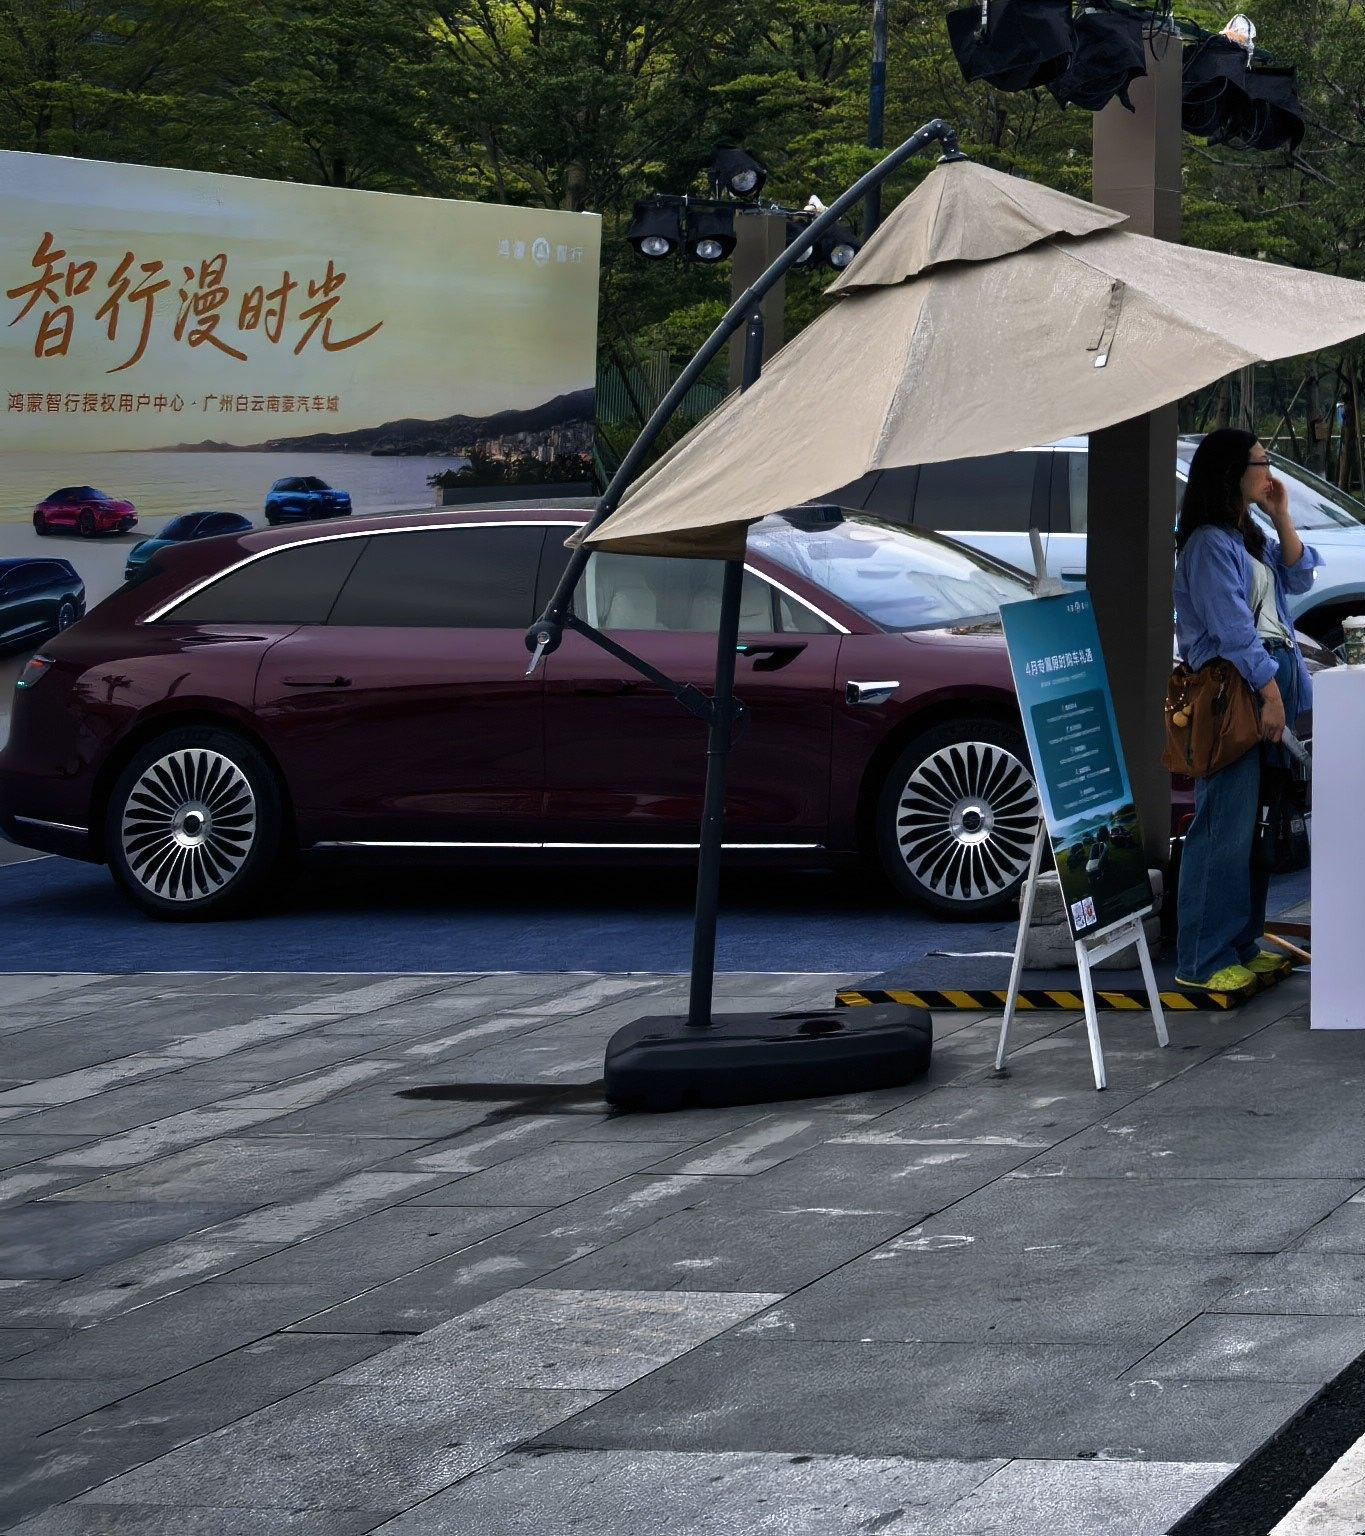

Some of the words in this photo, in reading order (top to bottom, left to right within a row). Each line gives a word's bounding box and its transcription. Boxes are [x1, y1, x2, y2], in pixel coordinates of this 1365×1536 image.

[7, 232, 384, 373] 智行漫时光
